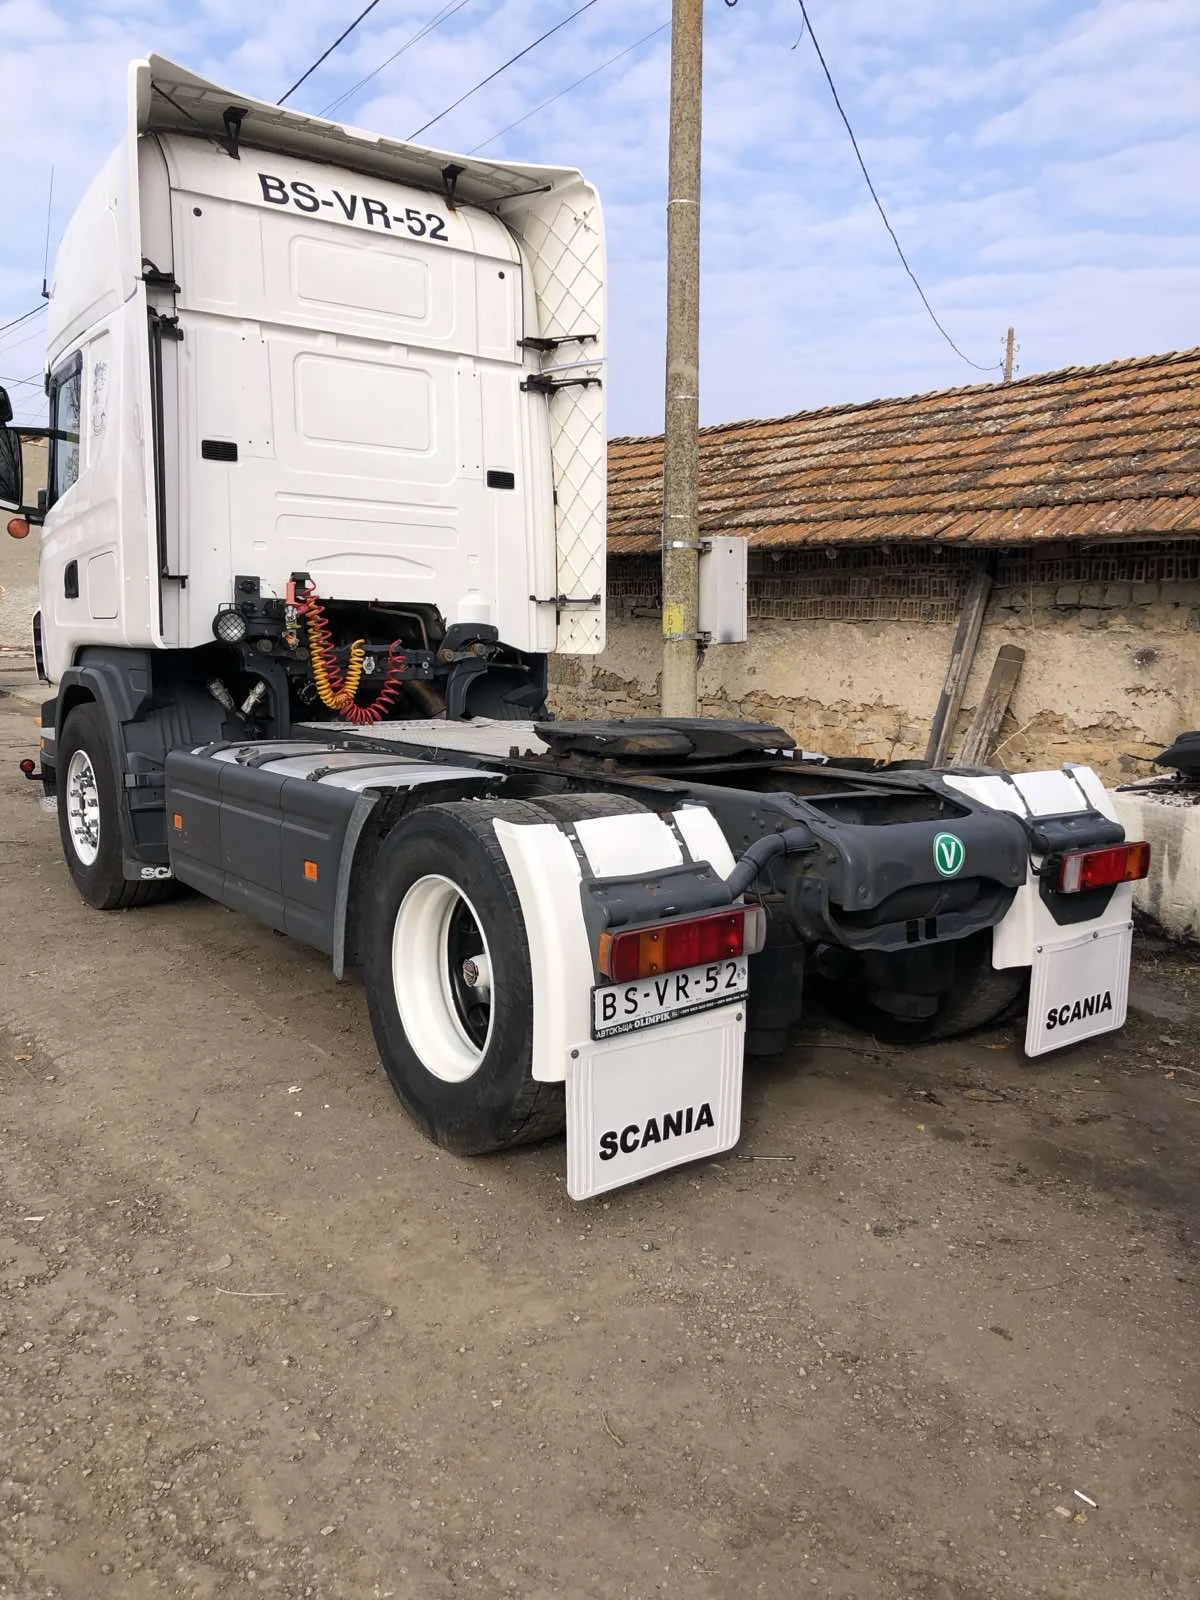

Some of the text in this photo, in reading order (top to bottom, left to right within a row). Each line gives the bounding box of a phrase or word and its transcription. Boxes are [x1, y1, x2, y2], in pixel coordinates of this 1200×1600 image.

[257, 172, 449, 242] BS-VR-52
[939, 840, 956, 869] V
[602, 961, 738, 1022] BS-VR-52
[1045, 991, 1112, 1030] SCANIA
[634, 1011, 671, 1028] OLIMPIK
[599, 1102, 714, 1161] SCANIA
